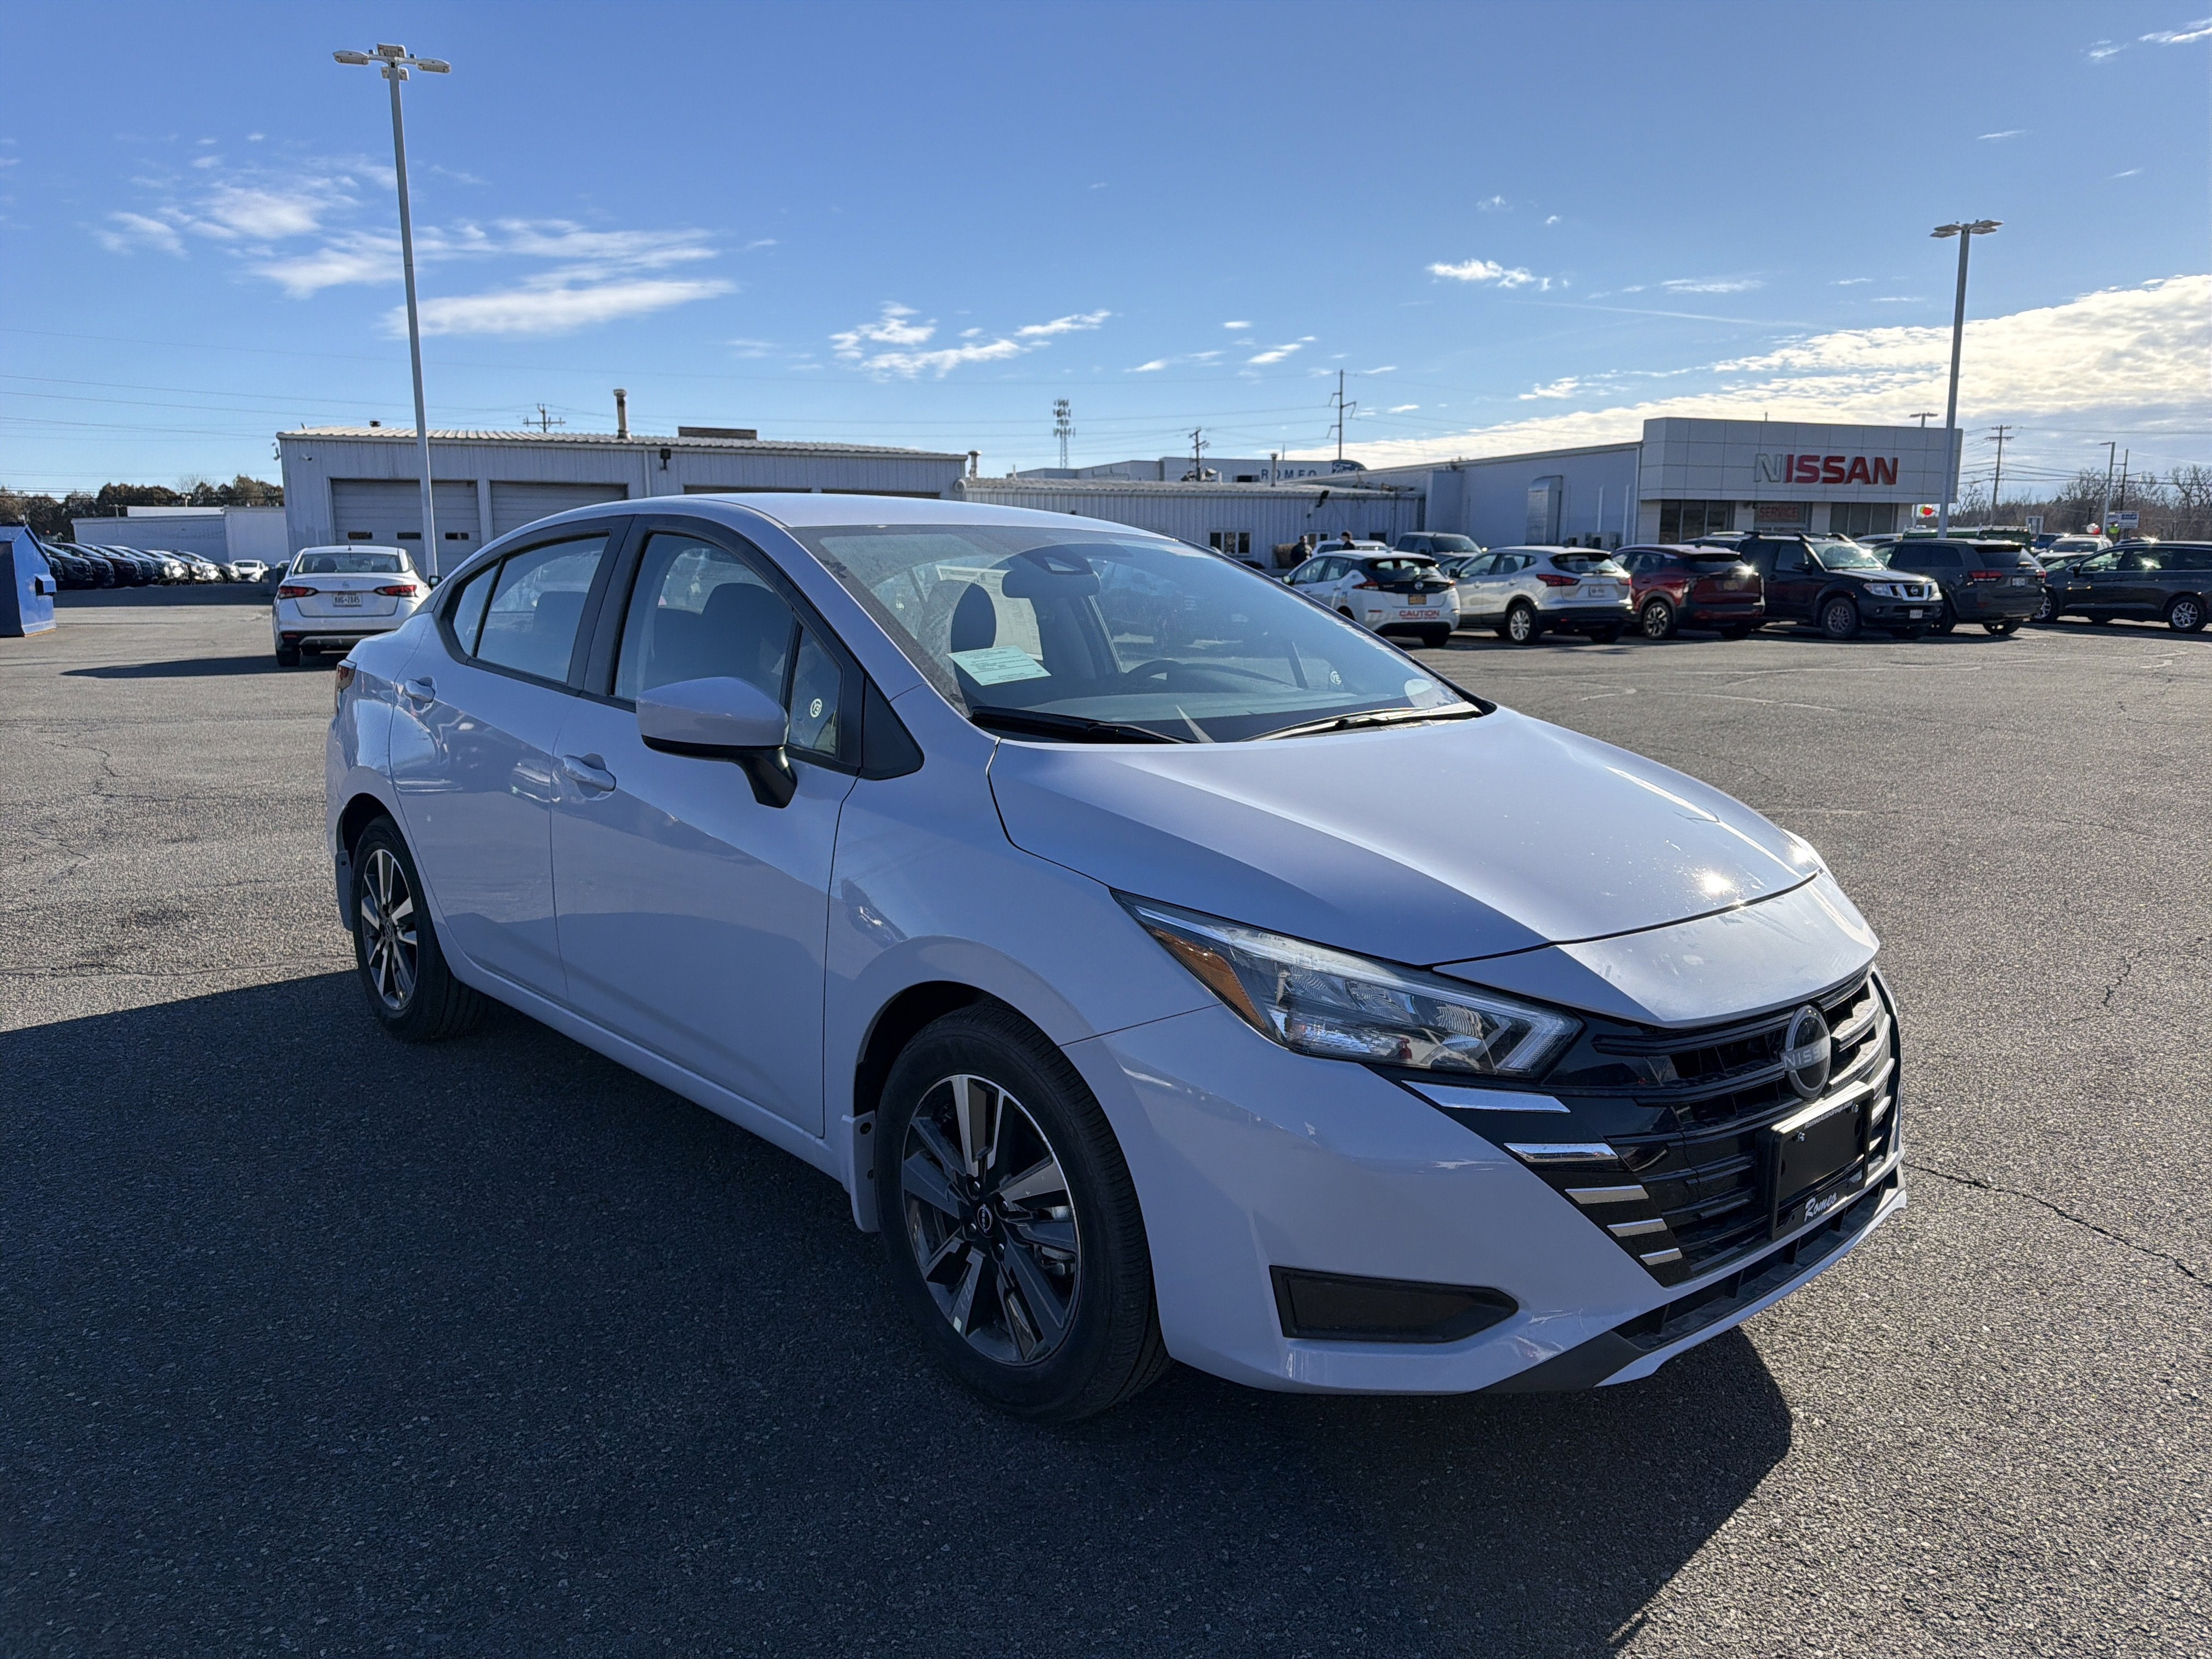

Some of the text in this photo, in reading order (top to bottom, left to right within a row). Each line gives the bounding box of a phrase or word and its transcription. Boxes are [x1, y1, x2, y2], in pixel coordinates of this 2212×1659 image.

[1754, 454, 1898, 485] NISSAN
[1760, 507, 1798, 518] SERVICE
[1783, 1045, 1821, 1069] NISS
[1804, 1192, 1837, 1222] Romeo
